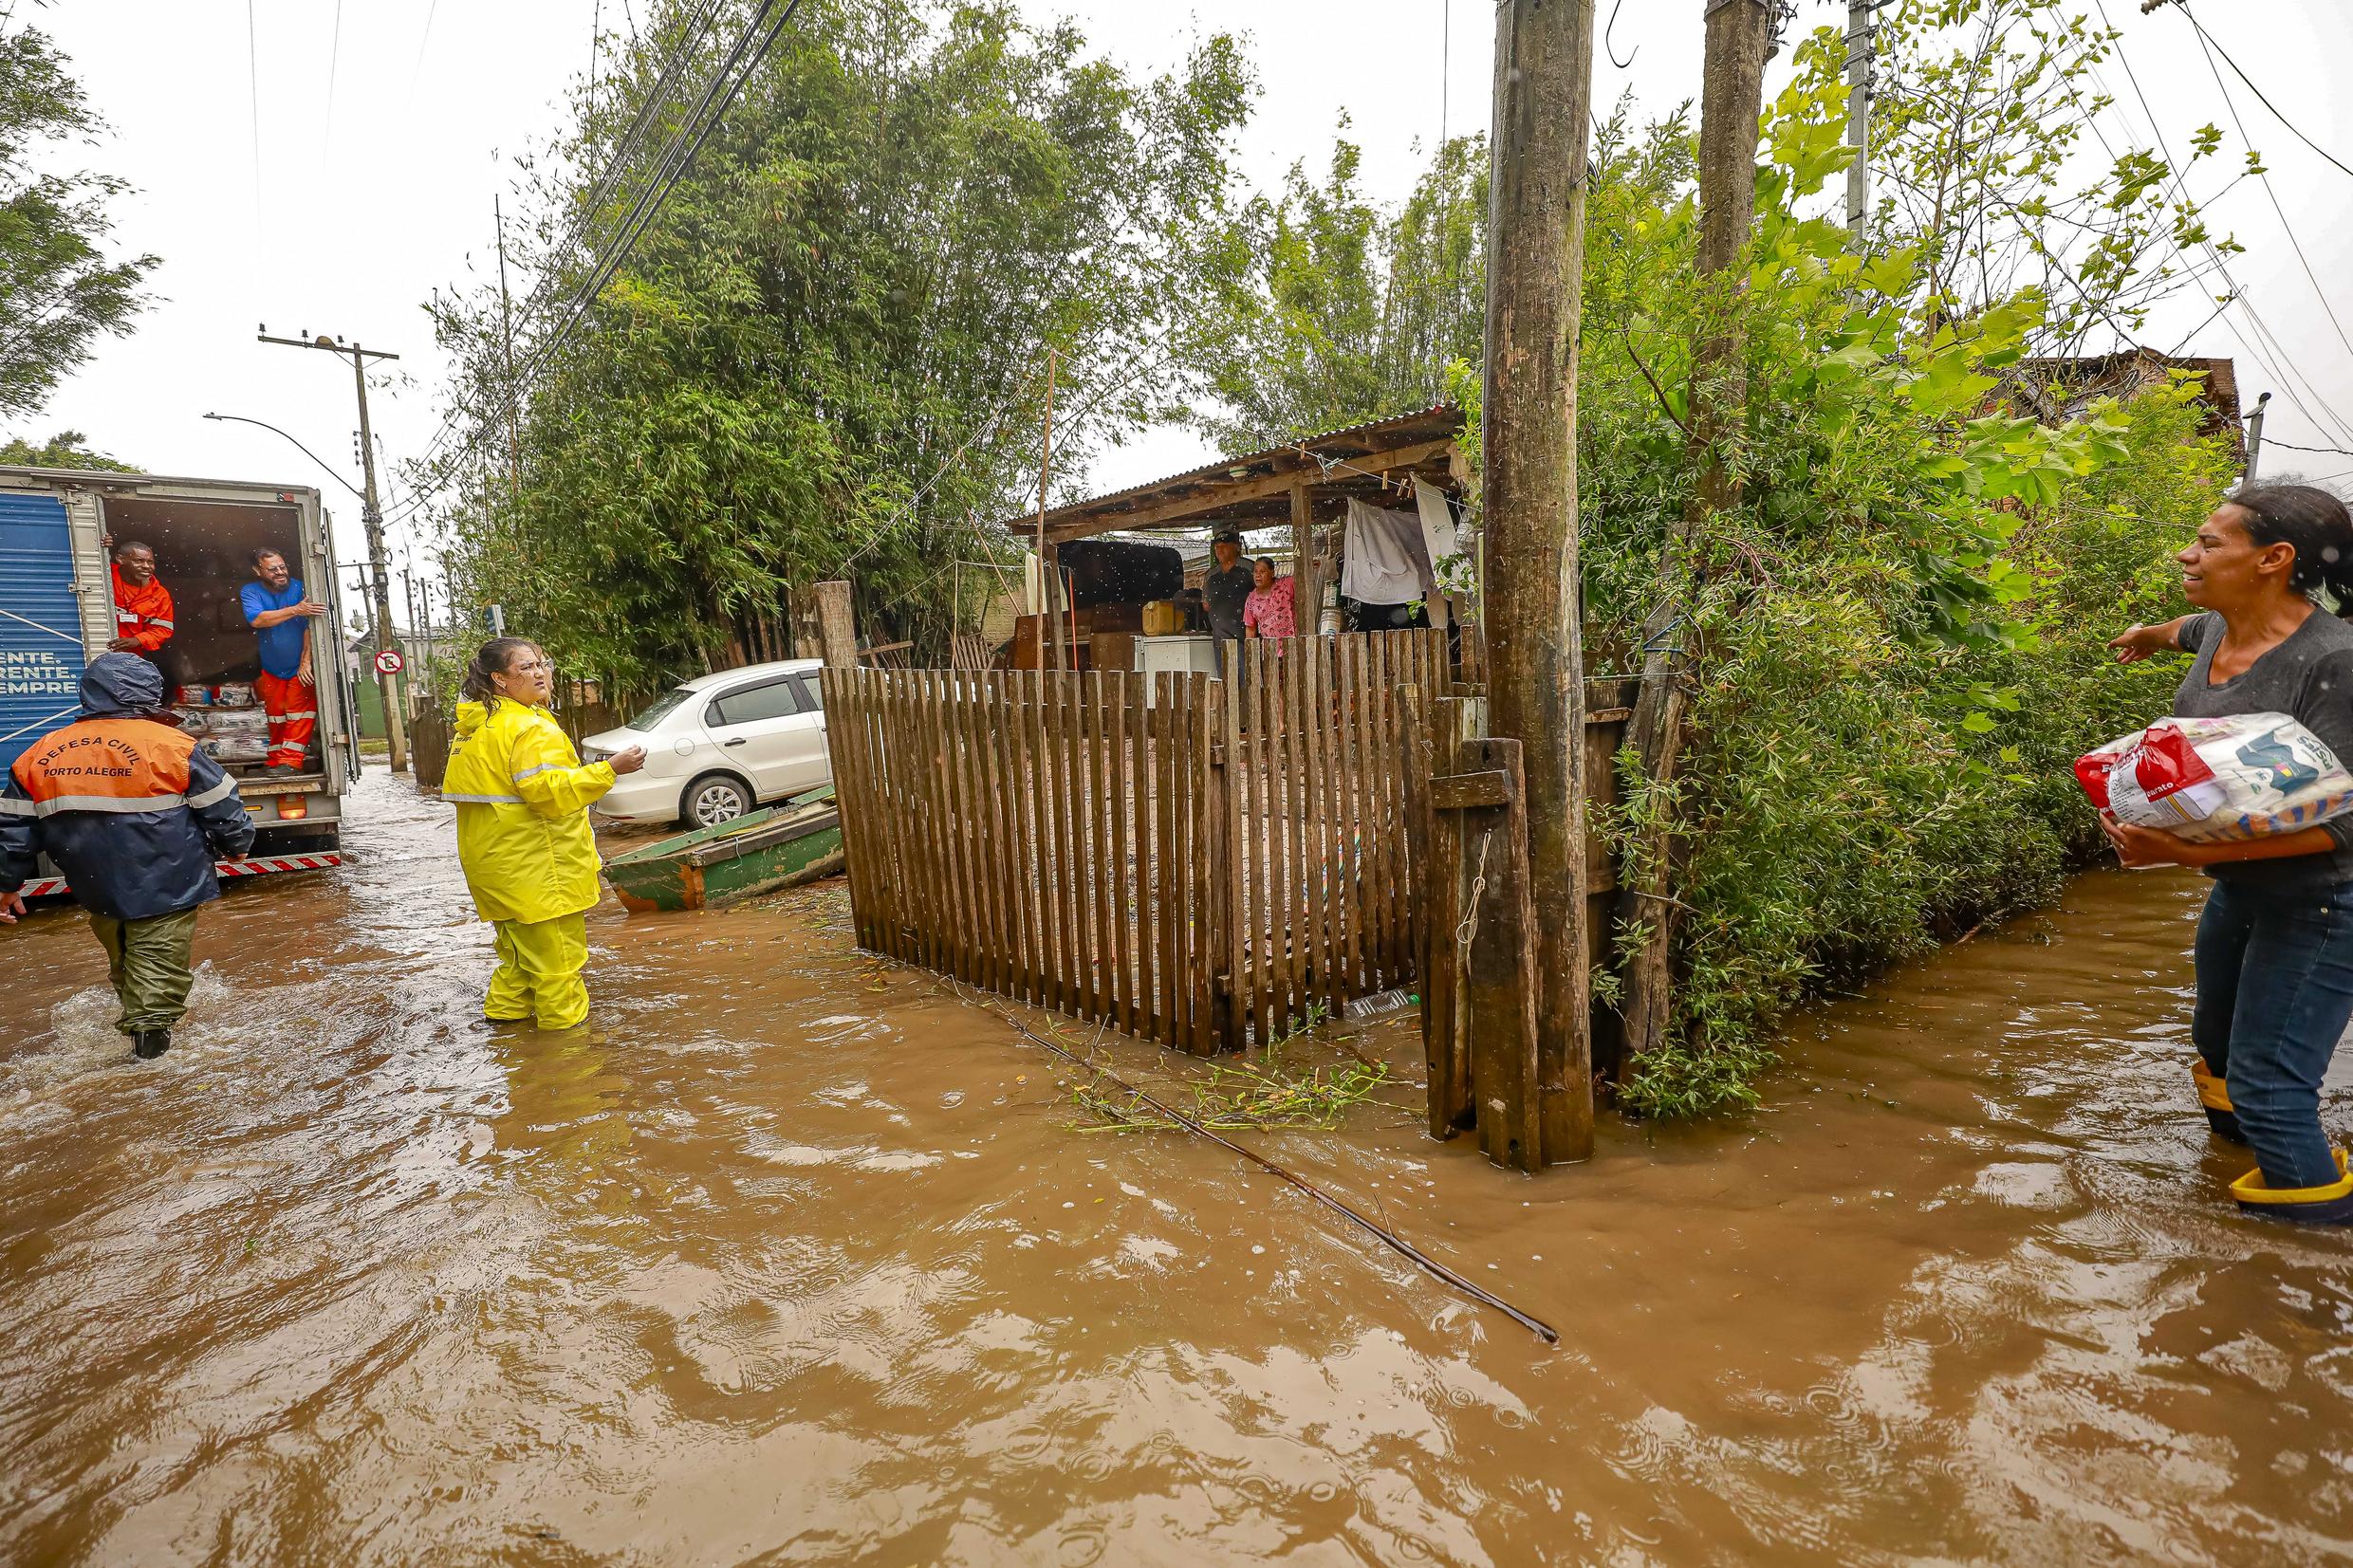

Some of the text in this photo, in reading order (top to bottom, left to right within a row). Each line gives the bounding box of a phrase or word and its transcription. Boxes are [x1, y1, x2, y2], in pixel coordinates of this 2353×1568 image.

[38, 736, 140, 766] DEFESA CIVIL
[44, 766, 133, 778] PORTO ALEGRE
